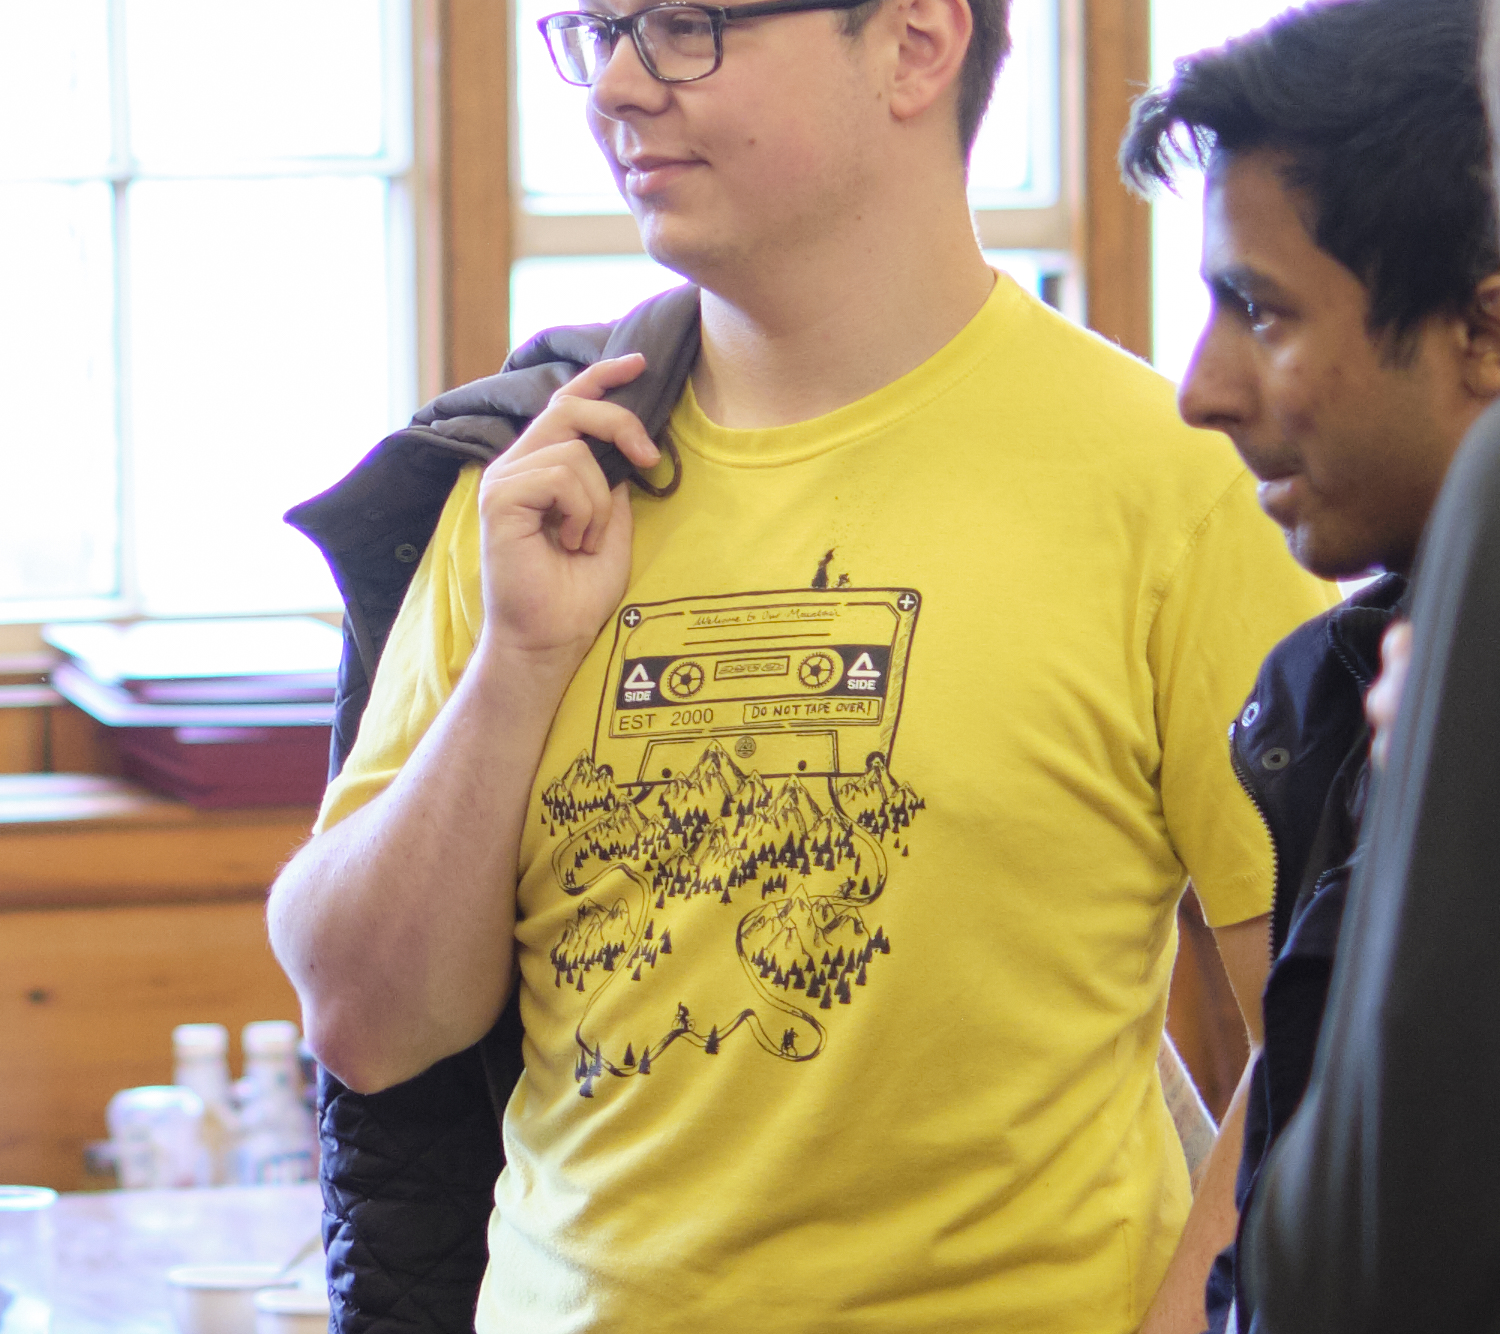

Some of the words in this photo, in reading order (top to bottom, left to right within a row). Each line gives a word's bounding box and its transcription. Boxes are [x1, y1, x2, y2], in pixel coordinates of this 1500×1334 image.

[693, 615, 741, 626] Welcome
[847, 679, 876, 690] SIDE
[624, 690, 652, 703] SIDE
[751, 705, 768, 719] DO
[773, 705, 802, 716] NOT
[804, 702, 831, 716] TAPE
[835, 700, 872, 716] OVER!
[619, 713, 657, 731] EST
[670, 708, 714, 727] 2000
